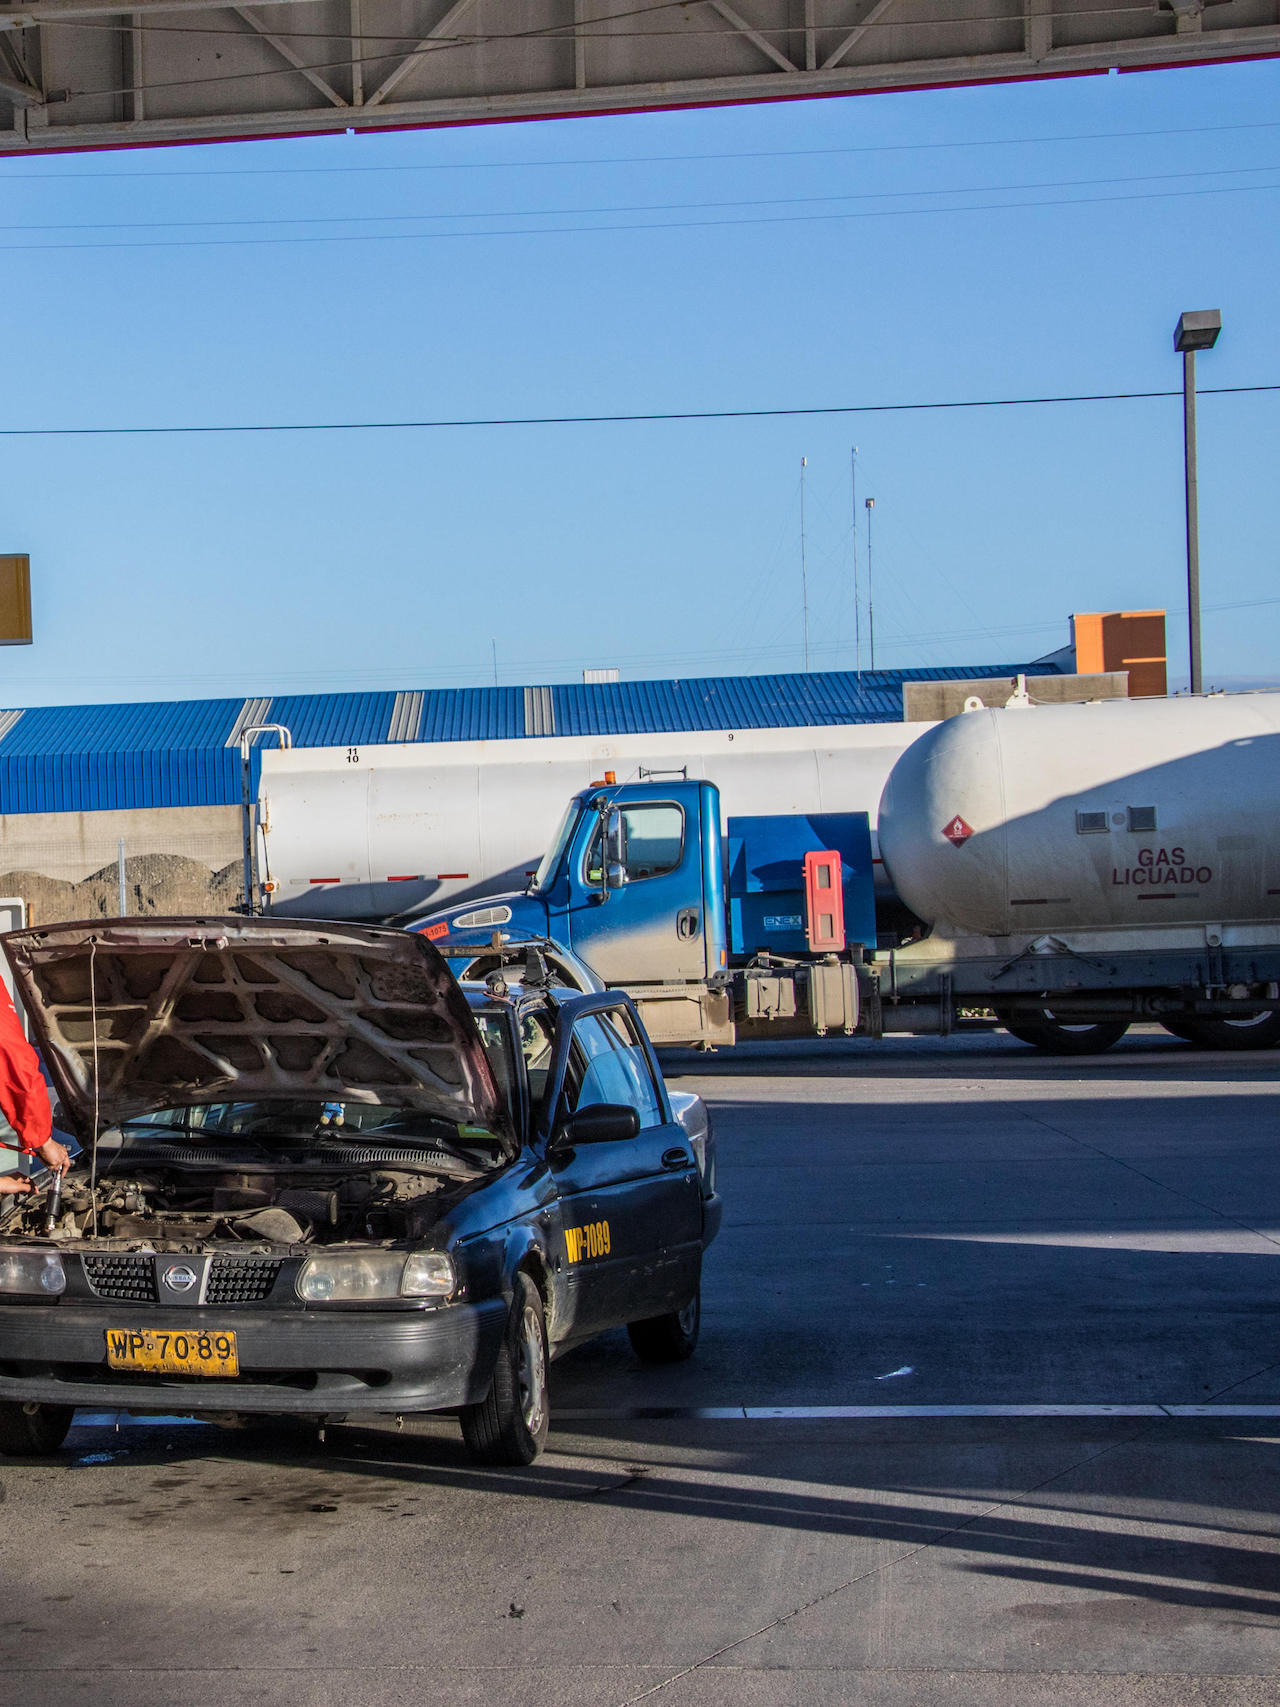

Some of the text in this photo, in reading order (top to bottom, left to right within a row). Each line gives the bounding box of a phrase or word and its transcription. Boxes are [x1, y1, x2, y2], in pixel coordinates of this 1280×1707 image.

[728, 733, 734, 742] 9
[347, 747, 357, 755] 11
[346, 755, 359, 763] 10
[1138, 847, 1185, 867] GAS
[1112, 866, 1212, 885] LICUADO
[765, 915, 800, 926] ENEX
